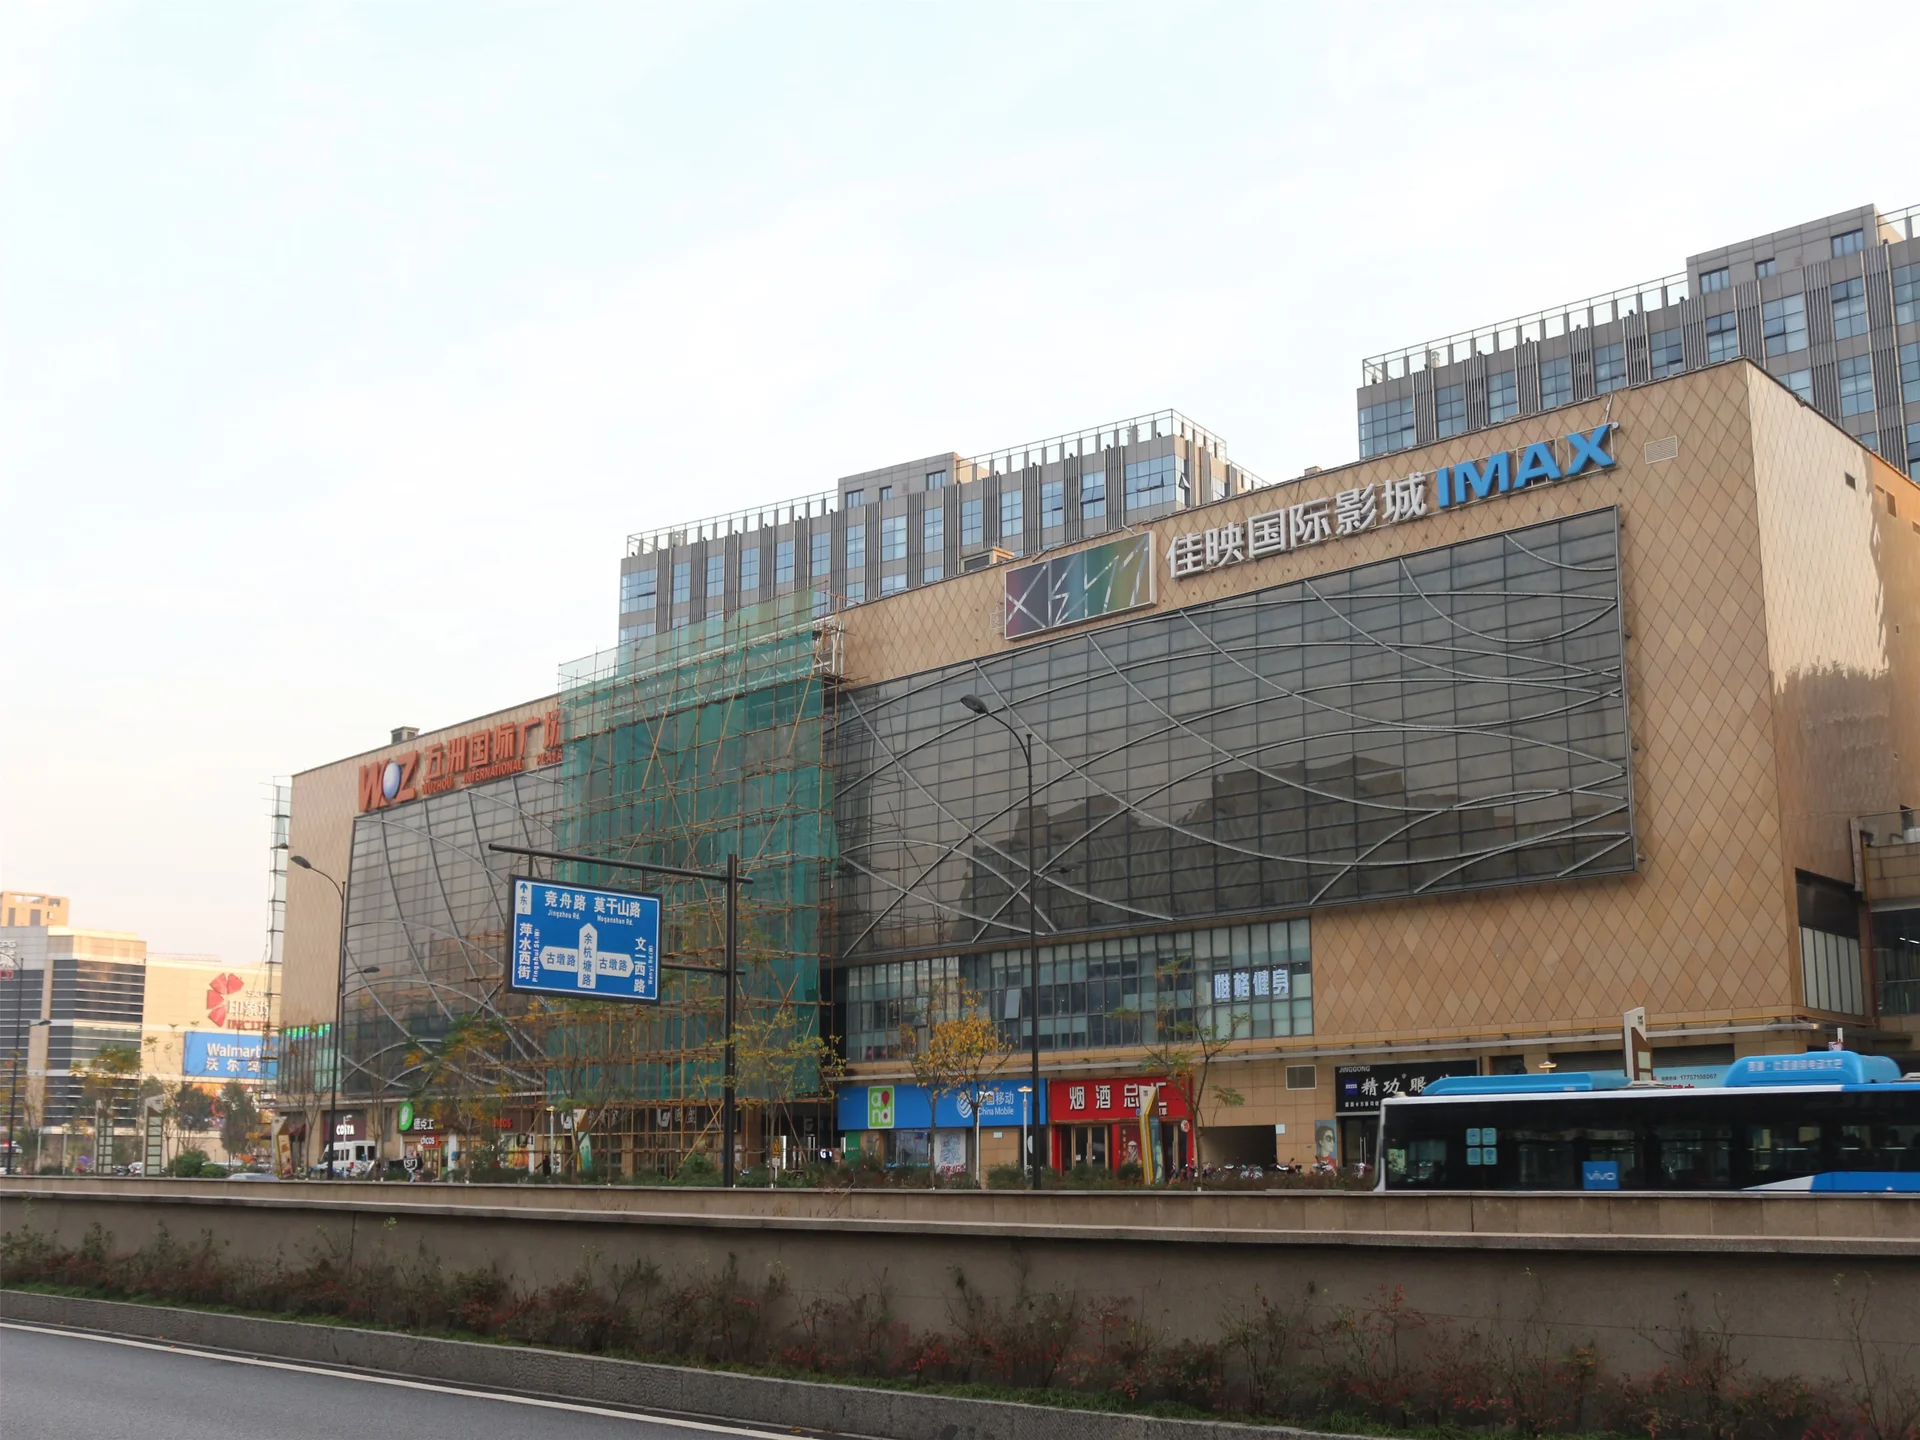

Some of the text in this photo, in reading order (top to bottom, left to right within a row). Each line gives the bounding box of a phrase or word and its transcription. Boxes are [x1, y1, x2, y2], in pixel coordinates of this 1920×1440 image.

[1167, 424, 1614, 580] 佳映国际影城 IMAX
[423, 710, 560, 781] 五洲国际广场
[422, 748, 563, 795] WUZHOU INTERNATIONAL PLAZA
[544, 890, 641, 918] 竞舟路 莫干山路
[547, 909, 634, 926] Jingzhou Rd. Moganshan Rd.
[517, 922, 533, 980] 萍水西街
[582, 932, 593, 986] 余杭塘路
[532, 949, 540, 983] Pingshui
[546, 952, 577, 967] 古墩路
[598, 958, 628, 973] 古墩路
[634, 937, 647, 993] 文一西路
[227, 1019, 270, 1031] INCIT
[206, 1042, 261, 1058] Walmart
[206, 1057, 261, 1073] 沃尔玛
[1338, 1065, 1371, 1073] JINGGONG
[1361, 1073, 1450, 1097] 精功眼
[976, 1090, 1014, 1105] 中国移动
[977, 1106, 1014, 1116] China Mobile
[336, 1124, 355, 1136] COSTA
[1586, 1170, 1617, 1181] vivo
